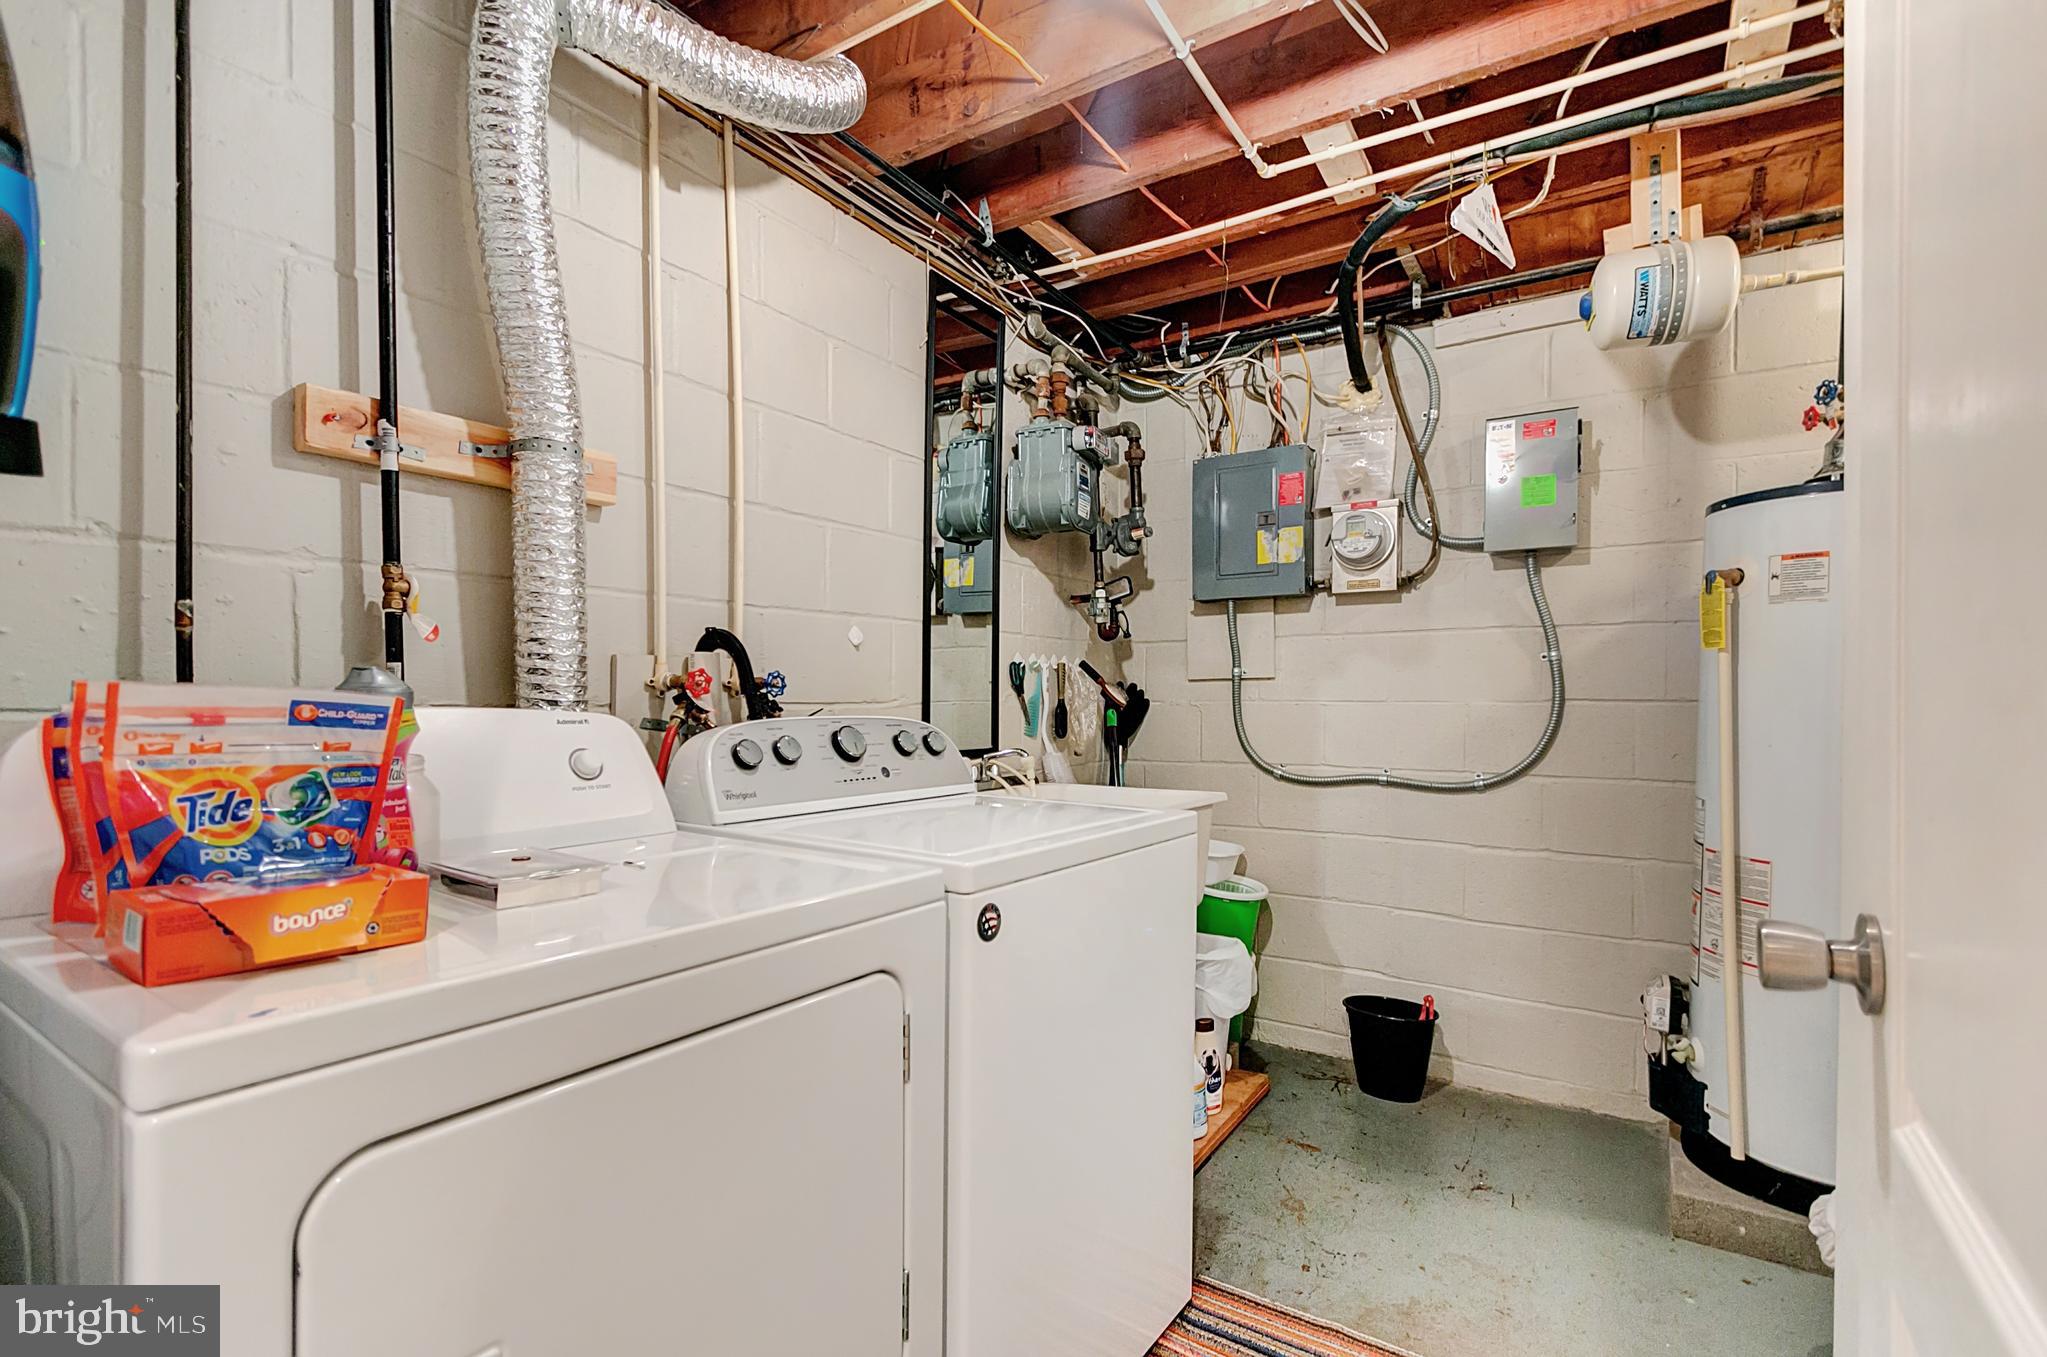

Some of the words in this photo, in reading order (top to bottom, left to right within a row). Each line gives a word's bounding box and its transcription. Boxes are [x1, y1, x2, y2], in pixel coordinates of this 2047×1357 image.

[1636, 281, 1650, 318] WATTS
[176, 789, 253, 833] Tide
[724, 790, 757, 801] Whirlpool
[199, 847, 252, 865] PODS
[272, 902, 347, 934] bounce
